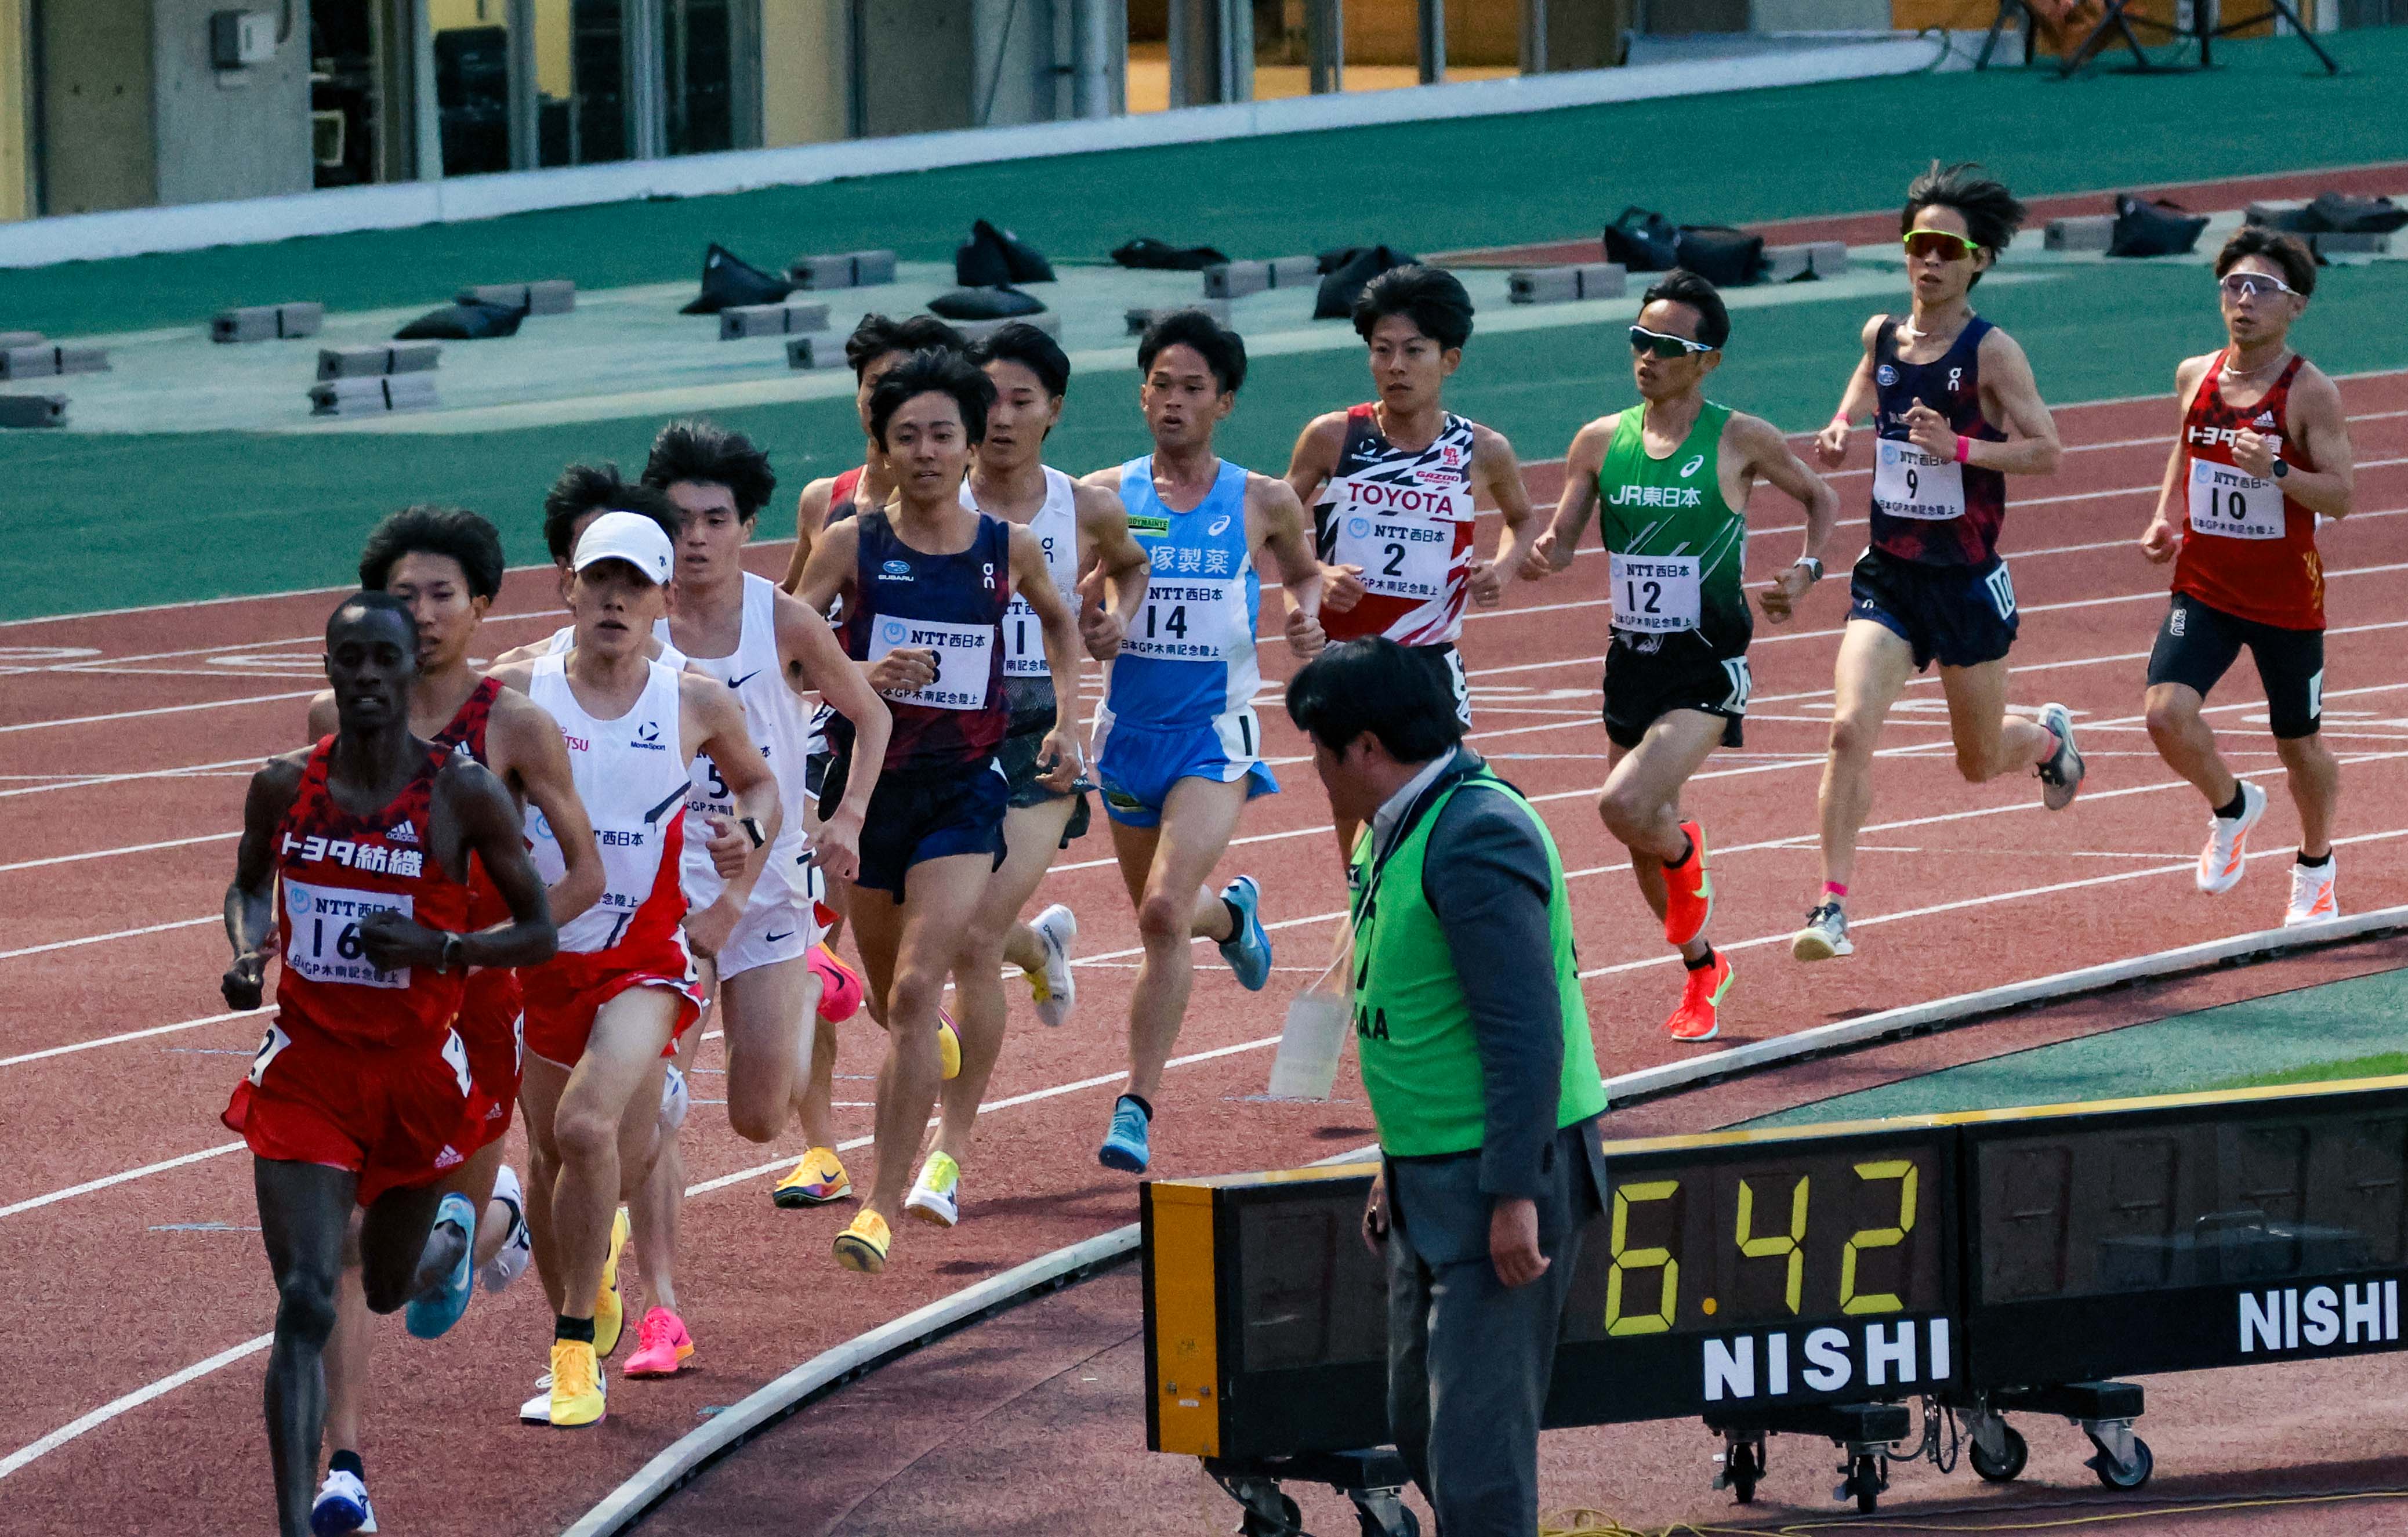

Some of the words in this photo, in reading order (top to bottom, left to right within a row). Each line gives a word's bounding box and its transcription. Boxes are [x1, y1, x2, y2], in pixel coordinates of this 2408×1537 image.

[1348, 482, 1453, 515] TOYOTA
[1610, 485, 1701, 508] JR東日本
[1907, 469, 1918, 499] 9
[2212, 488, 2246, 520] 10
[1374, 524, 1445, 542] NTT西日本
[1383, 543, 1405, 576] 2
[1627, 564, 1689, 578] NTT西日本
[1149, 587, 1223, 601] NTT西日本
[1627, 581, 1661, 613] 12
[1017, 621, 1024, 655] 1
[1147, 605, 1187, 639] 14
[911, 630, 985, 648] NTT西日本
[631, 741, 665, 751] MoveSport
[709, 764, 729, 799] 5
[281, 832, 423, 878] トヨタ紡織
[313, 918, 363, 960] 16
[2239, 1280, 2398, 1353] NISHI
[1703, 1318, 1950, 1401] NISHI
